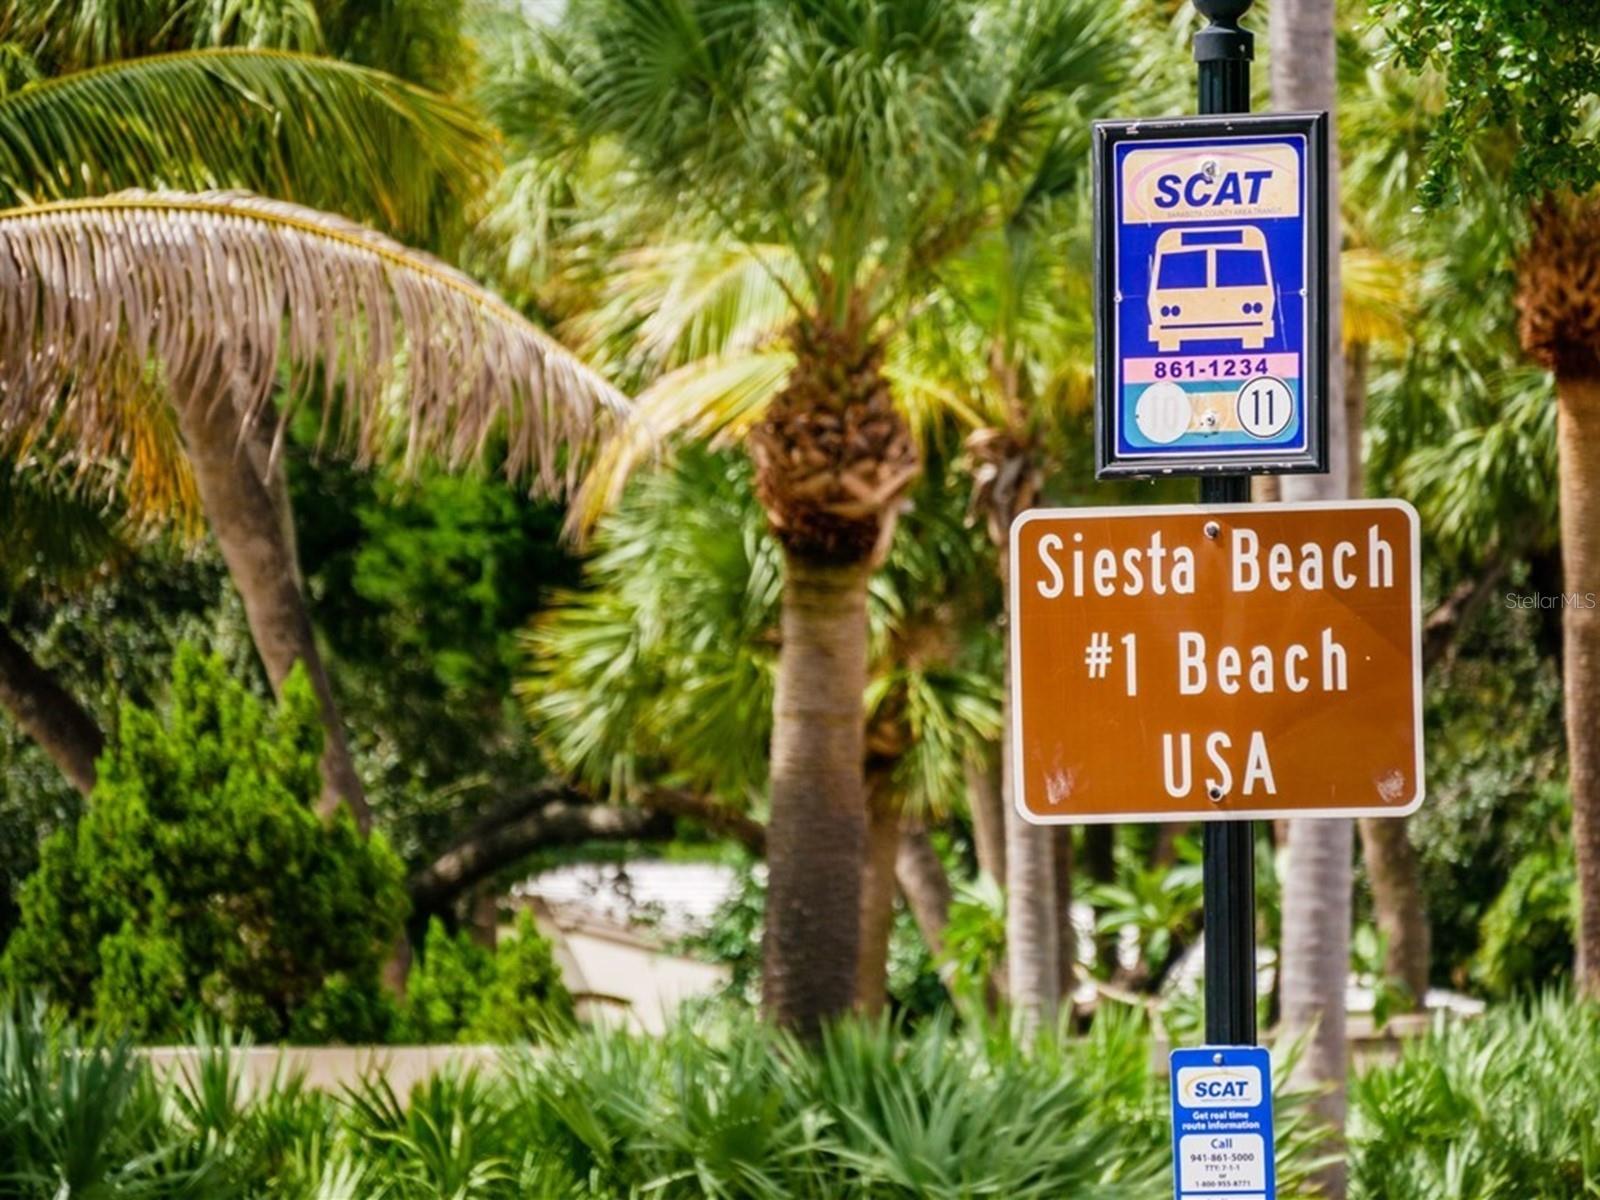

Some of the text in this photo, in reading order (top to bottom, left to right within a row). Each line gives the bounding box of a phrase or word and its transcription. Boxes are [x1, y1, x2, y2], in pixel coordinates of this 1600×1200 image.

[1154, 170, 1273, 209] SCAT
[1254, 207, 1282, 215] TRANSIT
[1154, 358, 1268, 378] 861-1234
[1252, 389, 1274, 426] 11
[1037, 524, 1393, 599] Siesta Beach
[1085, 627, 1348, 696] #1 Beach
[1163, 731, 1277, 798] USA
[1194, 1081, 1249, 1098] SCAT
[1192, 1110, 1249, 1120] Get real time
[1182, 1120, 1260, 1130] route information
[1210, 1138, 1233, 1149] Call
[1190, 1153, 1254, 1162] 941-861-5000
